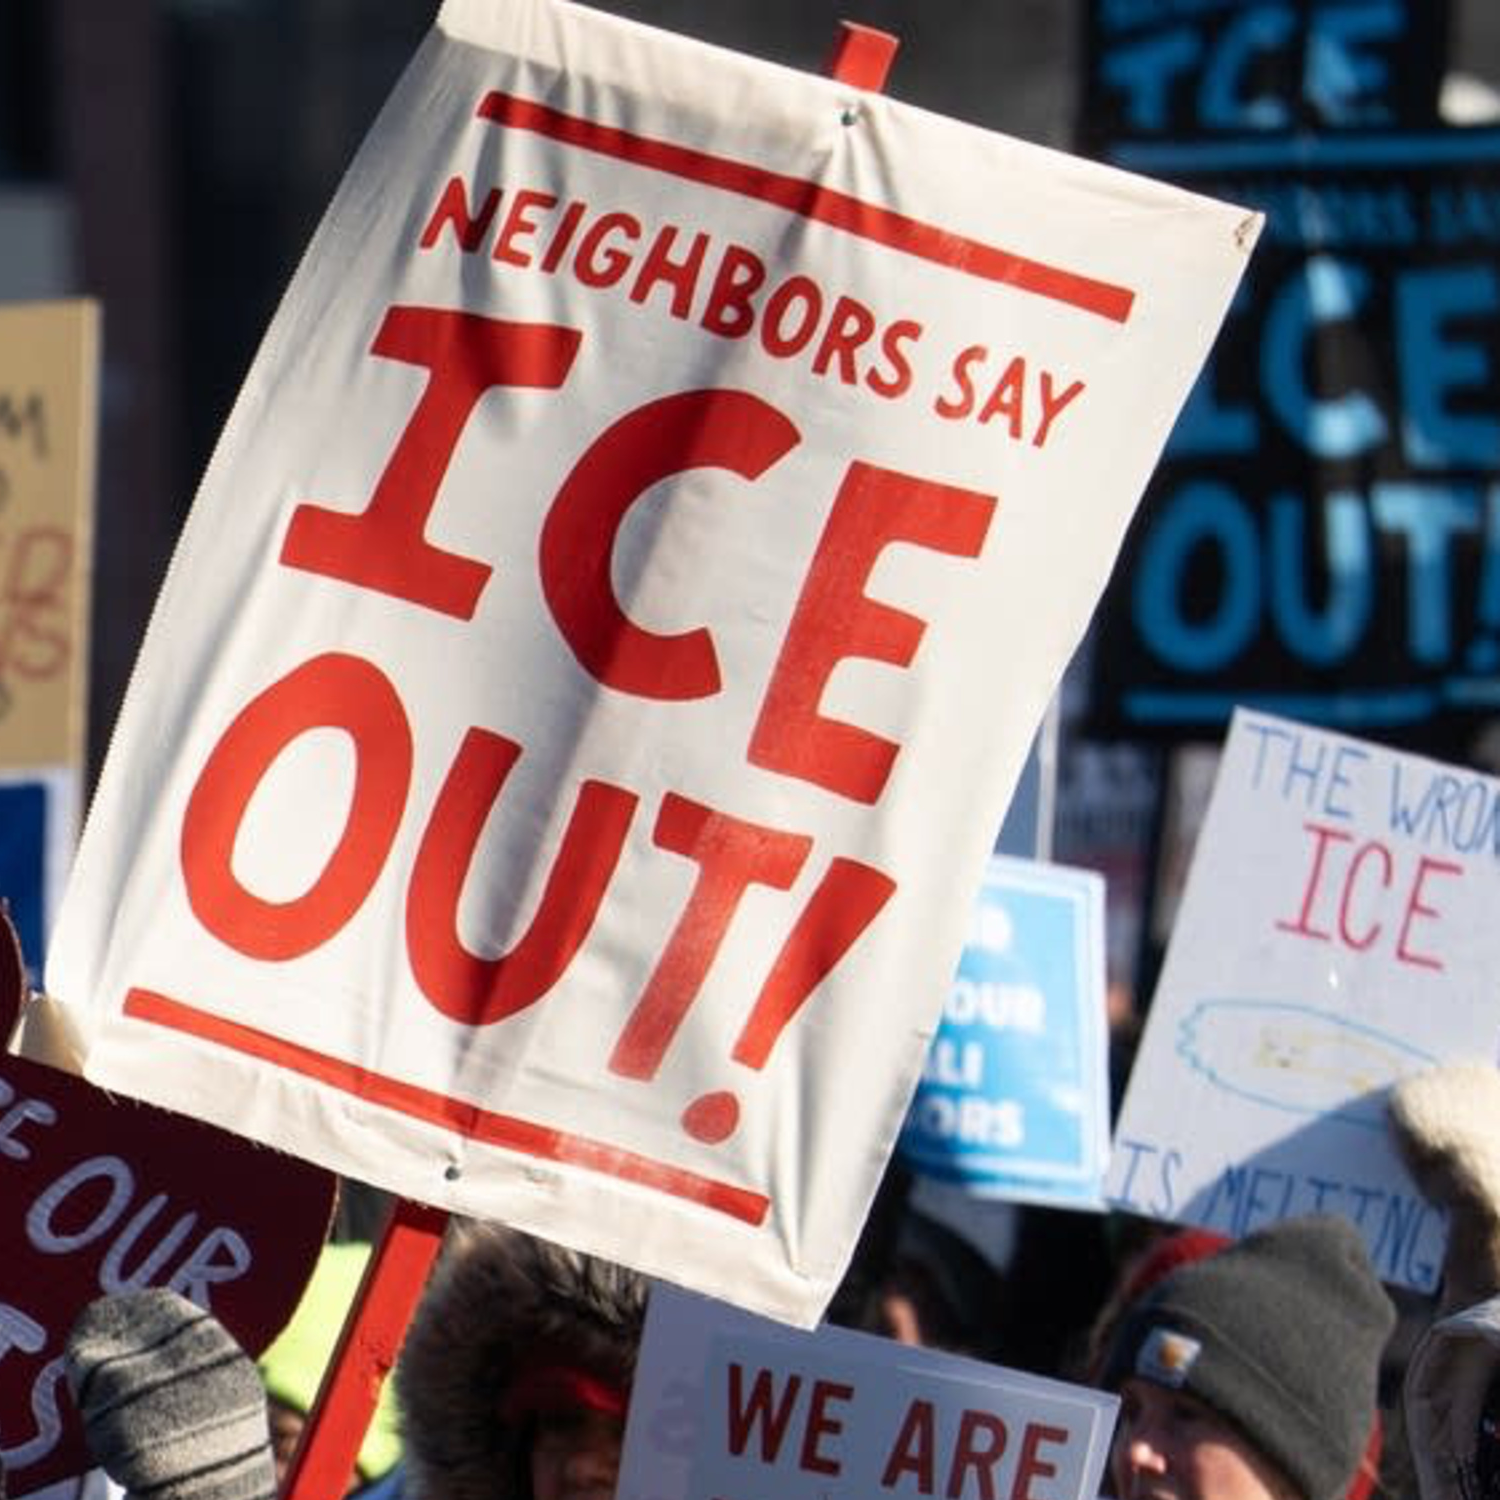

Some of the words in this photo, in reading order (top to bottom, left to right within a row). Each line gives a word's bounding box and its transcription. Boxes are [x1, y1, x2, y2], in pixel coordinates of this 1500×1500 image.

[421, 175, 920, 400] NEIGHBORS
[932, 344, 1085, 448] SAY
[278, 304, 997, 807] ICE
[1243, 722, 1369, 820] THE
[179, 651, 897, 1144] OUT!
[1274, 822, 1466, 974] ICE
[25, 1155, 252, 1308] OUR
[1103, 1140, 1184, 1219] IS
[725, 1362, 854, 1477] WE
